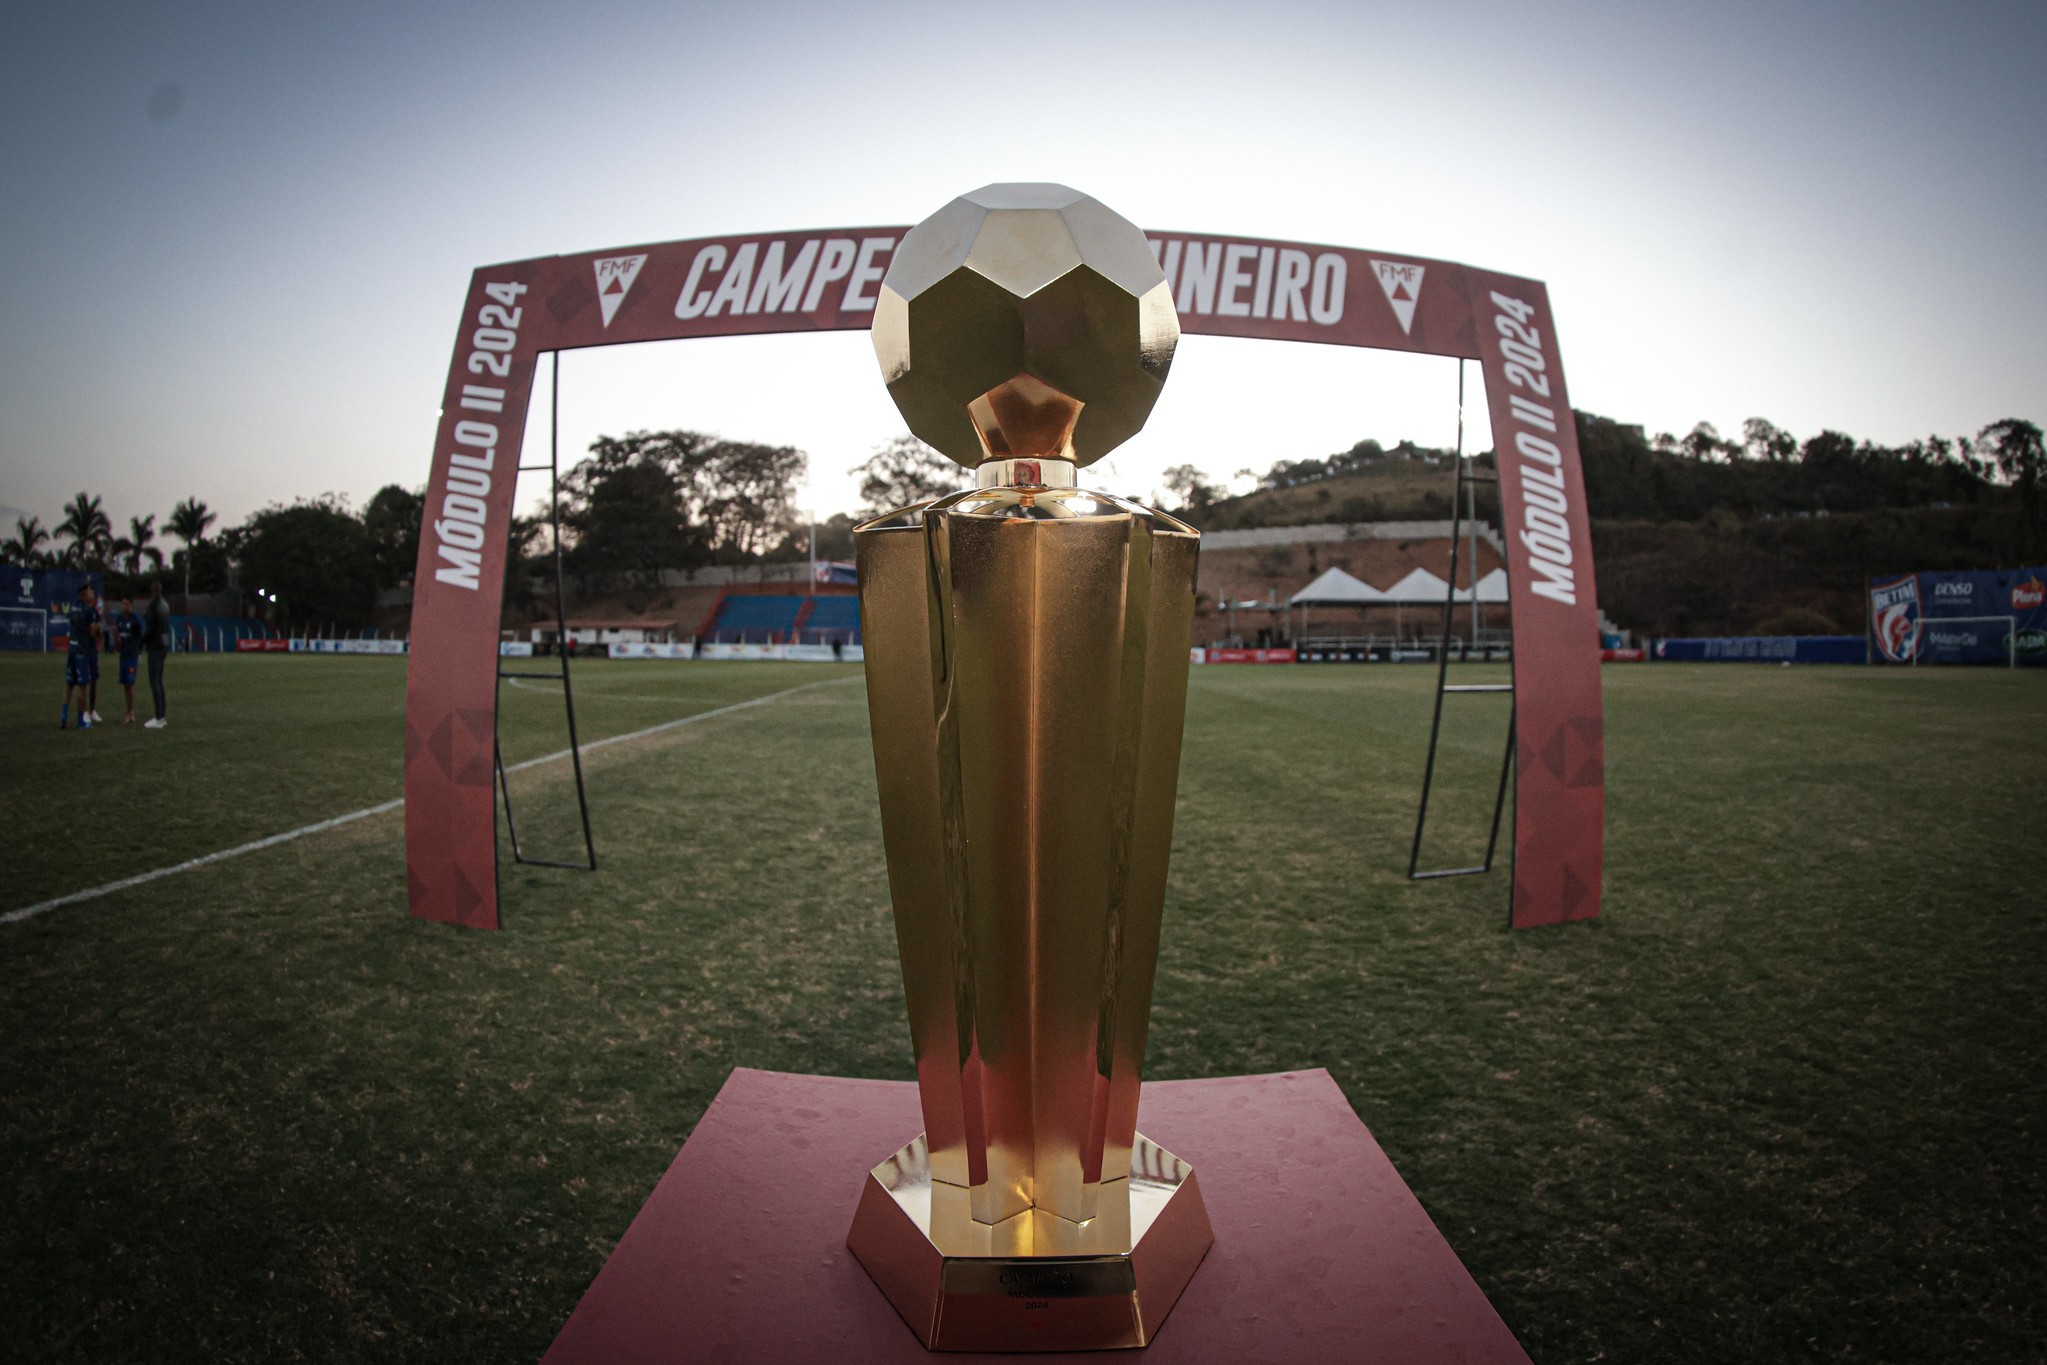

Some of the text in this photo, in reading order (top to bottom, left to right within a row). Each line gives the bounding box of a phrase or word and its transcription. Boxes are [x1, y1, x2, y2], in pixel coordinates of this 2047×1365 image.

[599, 257, 639, 277] FMF
[1379, 263, 1418, 283] FMF
[674, 237, 1348, 326] CAMPE INEIRO
[435, 281, 528, 591] MÓDULO II 2024
[1489, 290, 1577, 606] MÓDULO II 2024
[1874, 582, 1915, 610] BETIM
[1025, 1301, 1049, 1310] 2024
